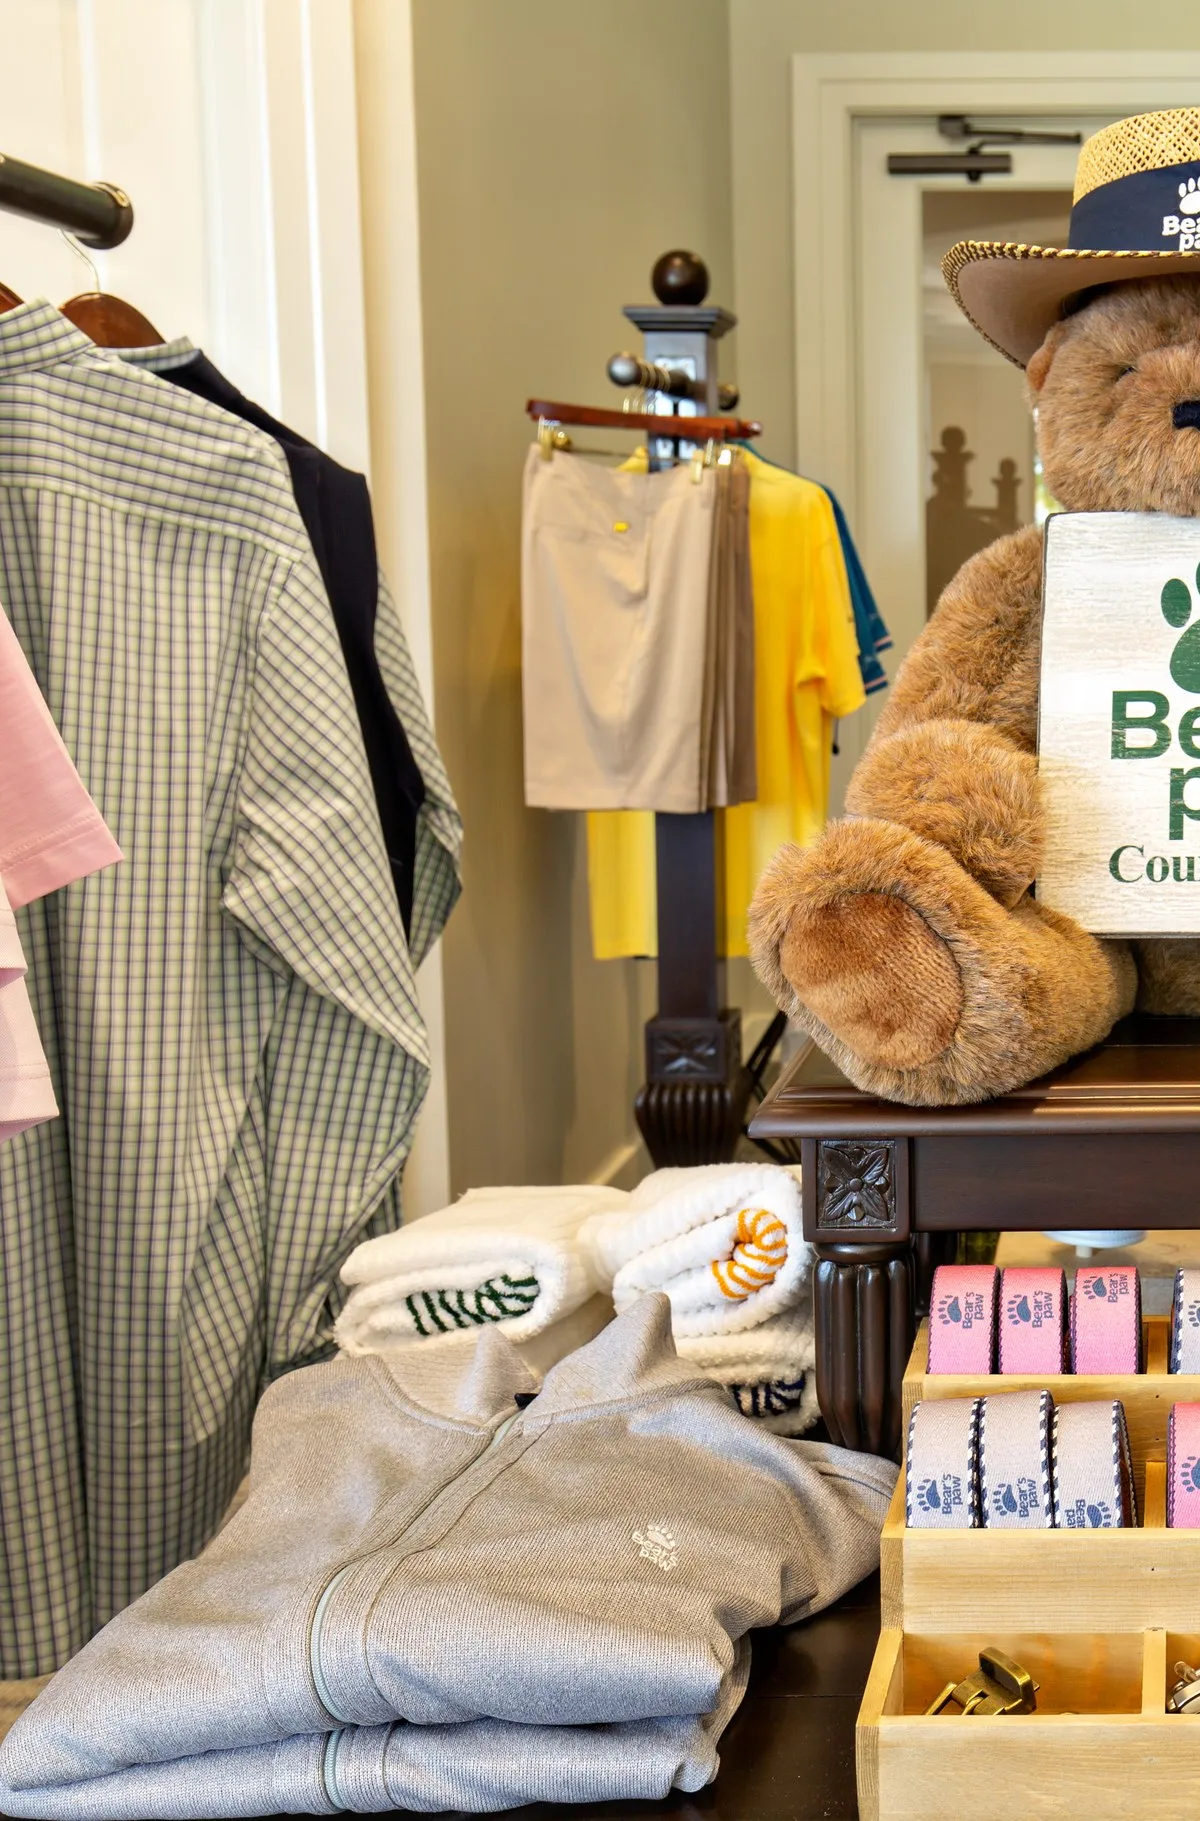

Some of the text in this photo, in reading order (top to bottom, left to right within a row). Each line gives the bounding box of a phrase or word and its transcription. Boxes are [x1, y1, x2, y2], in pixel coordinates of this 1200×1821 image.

[1107, 1272, 1119, 1303] Bear's
[1118, 1273, 1130, 1295] paw
[962, 1291, 975, 1329] Bear's
[973, 1293, 985, 1320] paw
[1032, 1290, 1044, 1328] Bear's
[1043, 1292, 1054, 1319] paw
[942, 1473, 952, 1515] Bear's
[951, 1475, 963, 1505] paw
[1018, 1477, 1029, 1518] Bear's
[1027, 1479, 1040, 1508] paw
[1065, 1509, 1076, 1528] pa
[631, 1531, 678, 1566] Bear's
